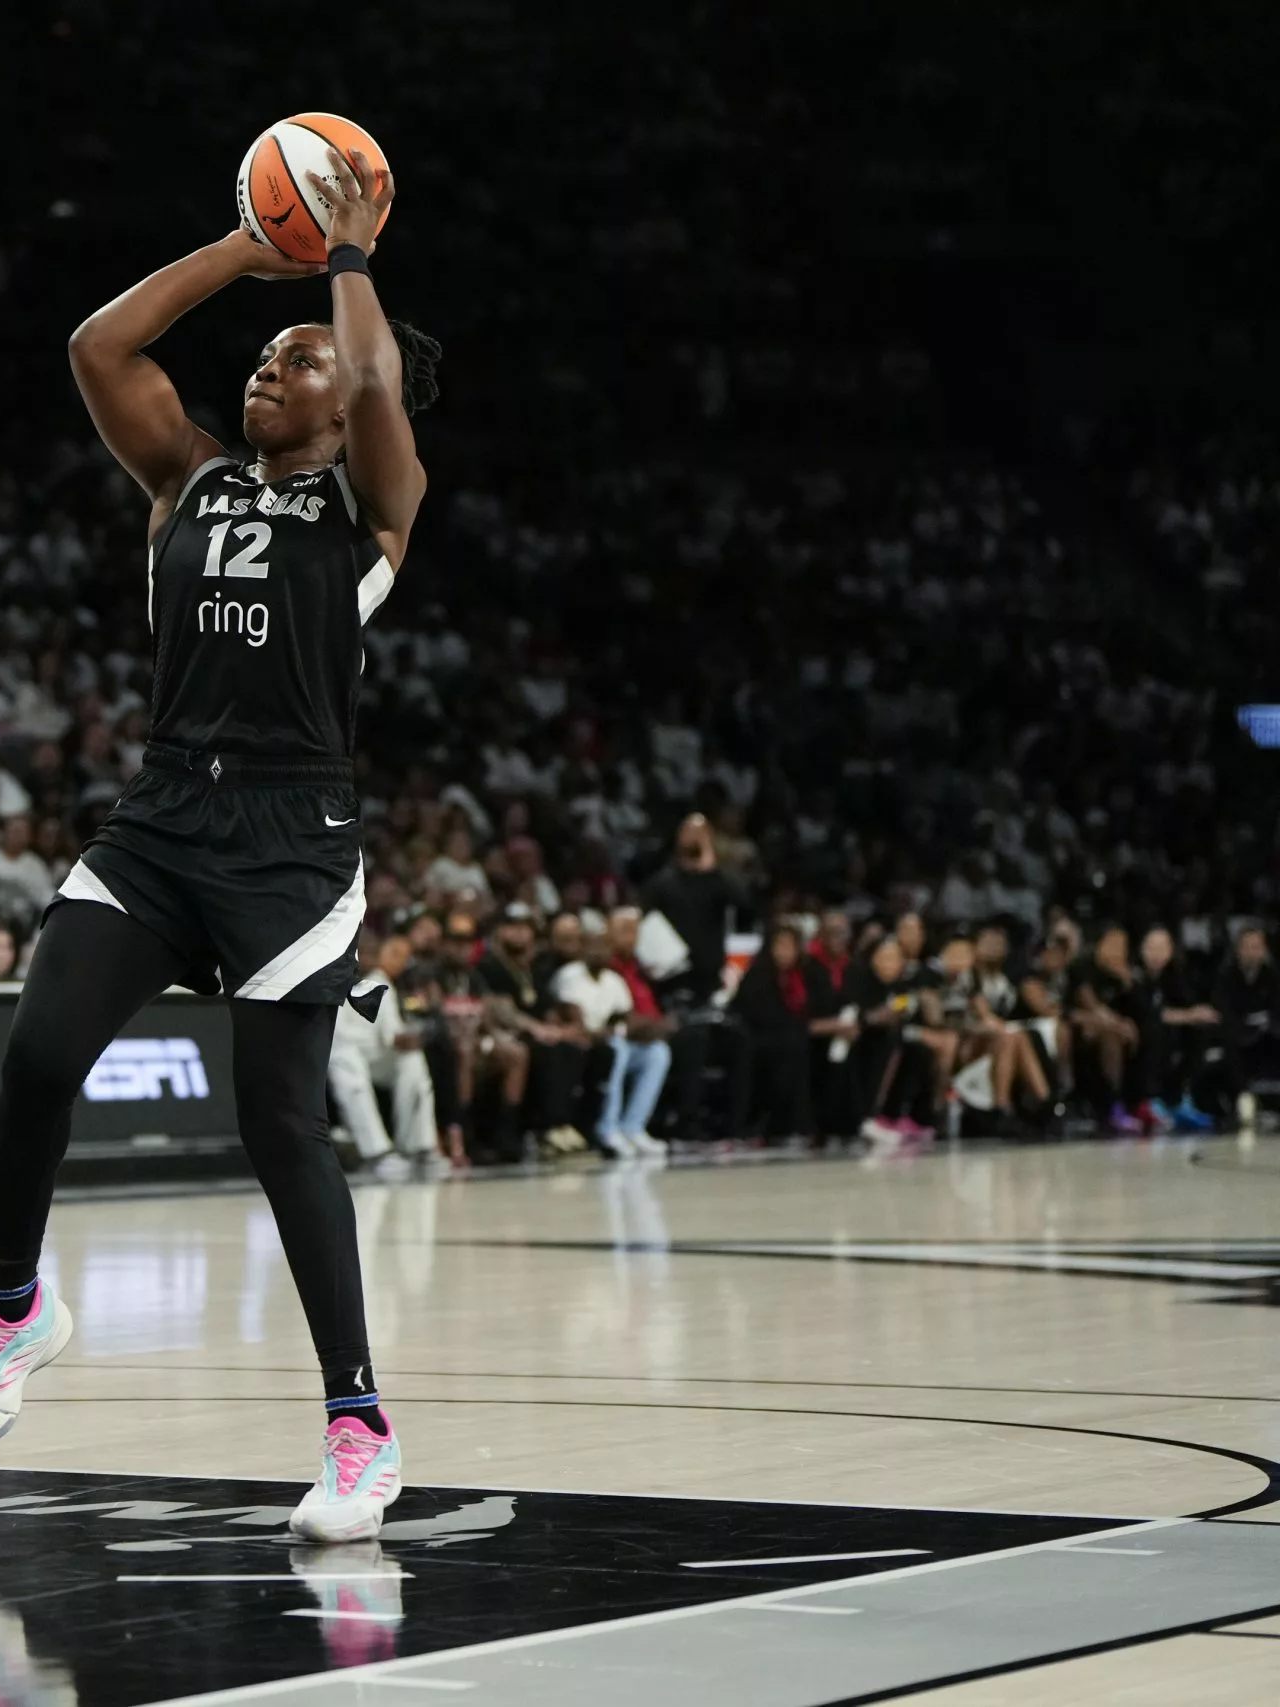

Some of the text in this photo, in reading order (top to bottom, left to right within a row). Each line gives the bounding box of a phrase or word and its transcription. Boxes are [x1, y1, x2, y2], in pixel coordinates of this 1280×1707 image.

[196, 484, 326, 522] LAS EGAS
[202, 519, 272, 579] 12
[197, 591, 269, 647] ring
[82, 1037, 209, 1101] ESPN
